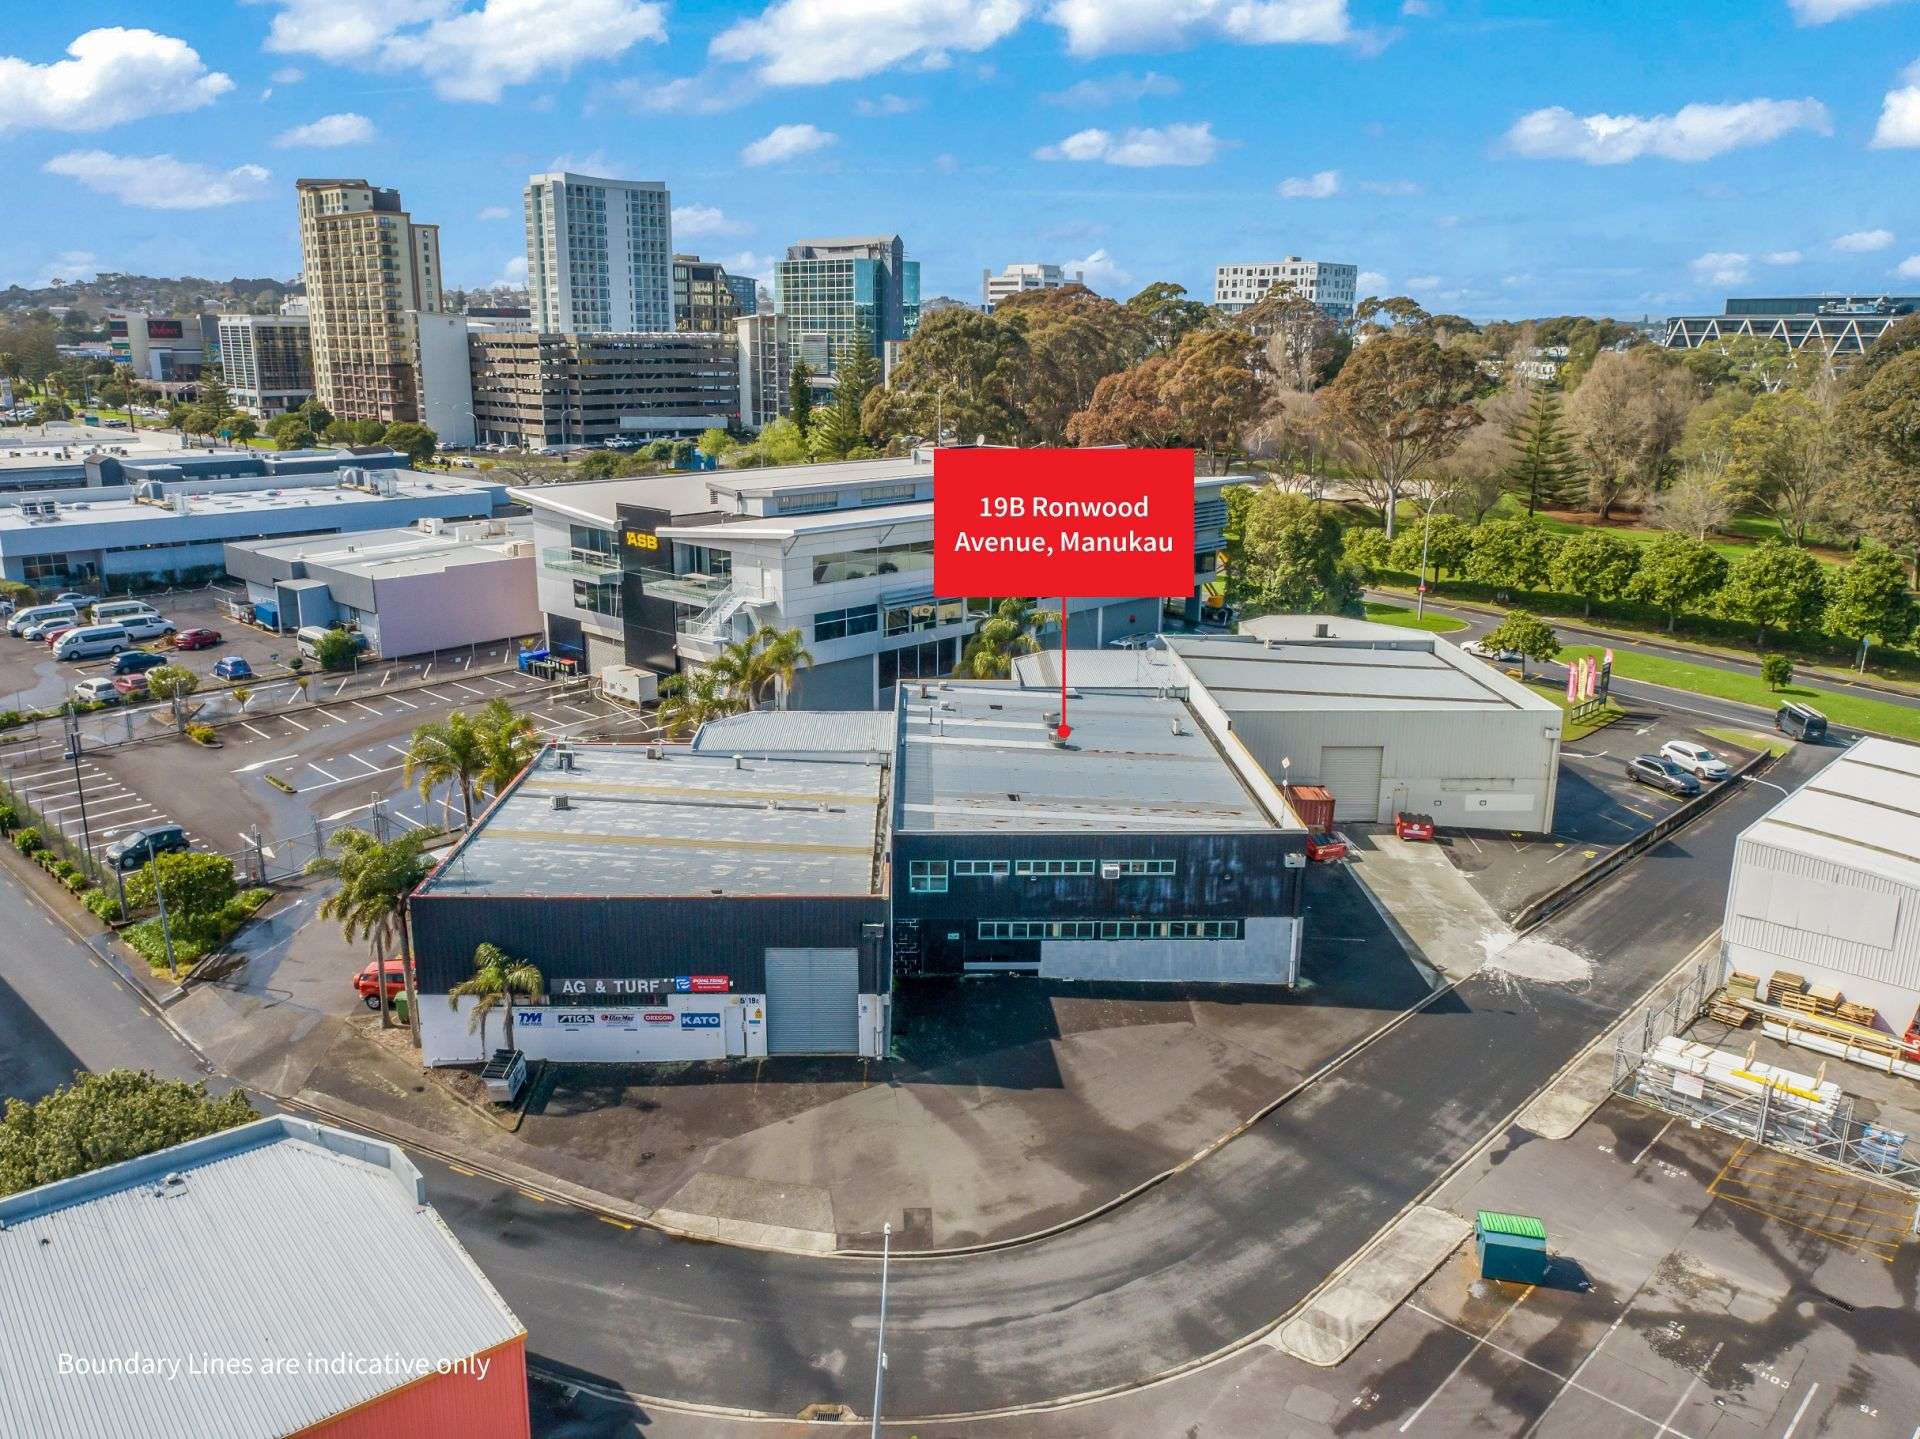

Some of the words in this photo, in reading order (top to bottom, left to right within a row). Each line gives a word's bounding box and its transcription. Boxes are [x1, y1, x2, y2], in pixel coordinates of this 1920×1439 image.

[626, 531, 658, 550] ASB
[562, 980, 586, 993] AG
[595, 980, 606, 993] &
[613, 980, 660, 993] TURF
[518, 1012, 543, 1023] TYM
[558, 1014, 595, 1024] STIGA
[643, 1014, 674, 1022] OREGON
[682, 1016, 719, 1025] KATO
